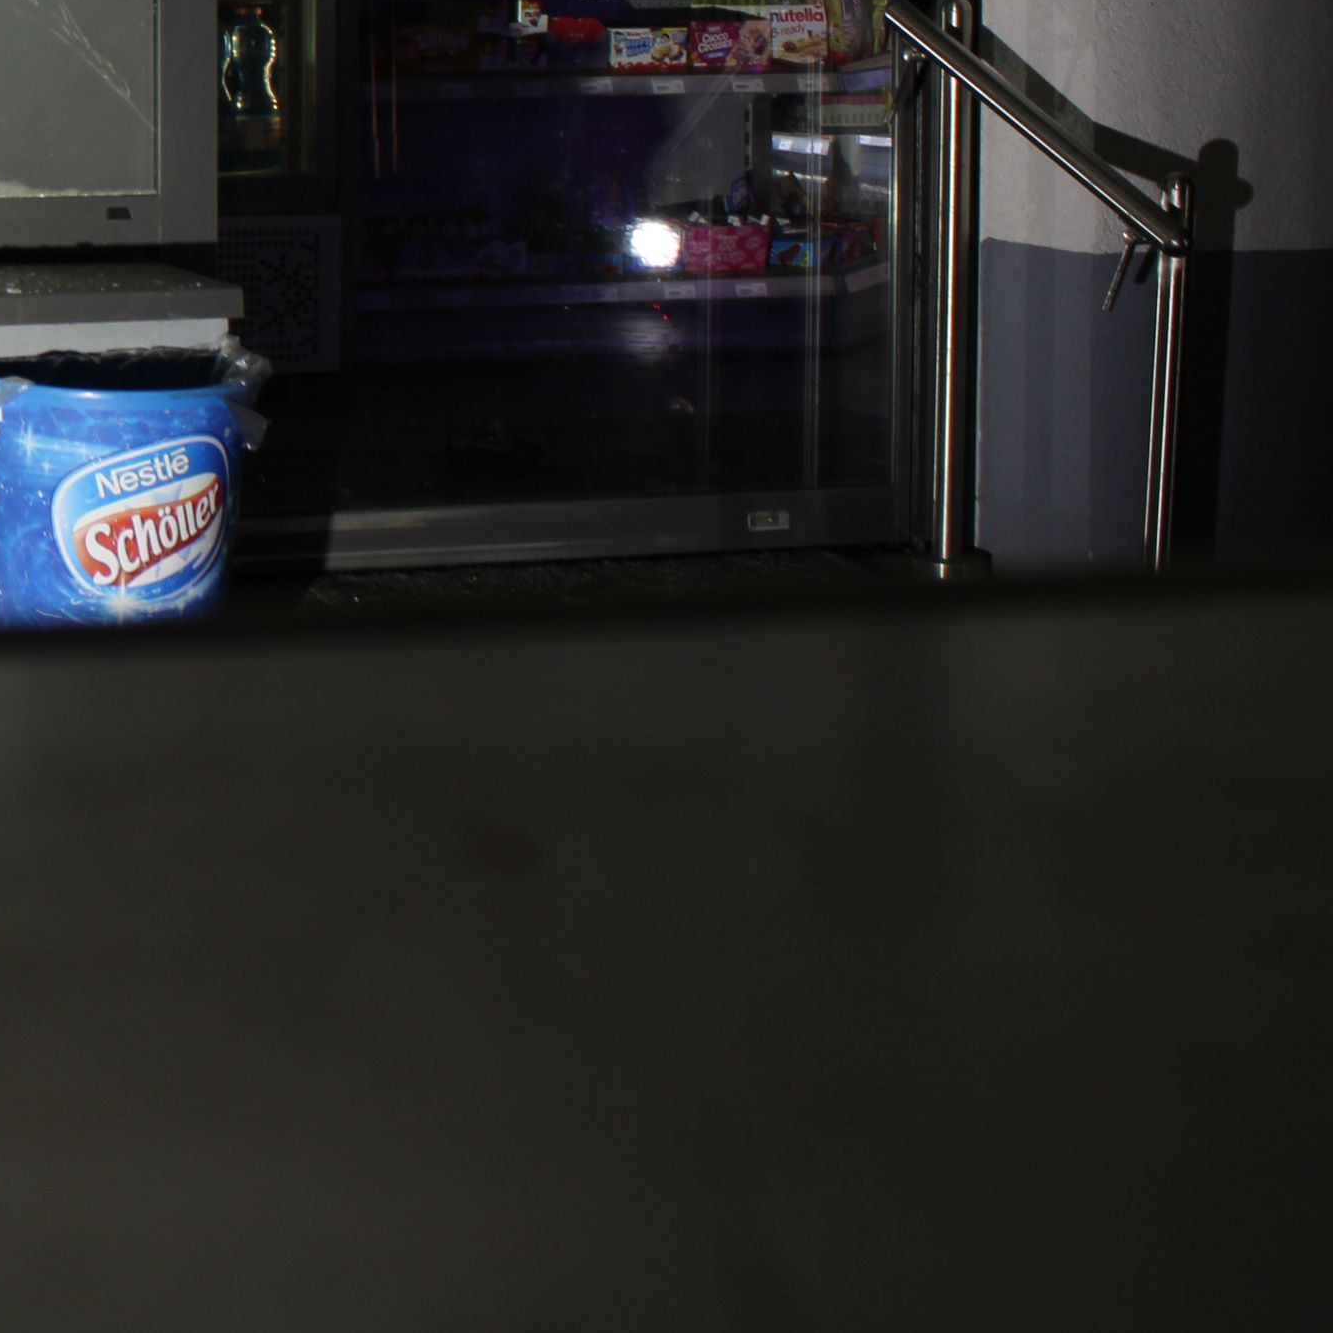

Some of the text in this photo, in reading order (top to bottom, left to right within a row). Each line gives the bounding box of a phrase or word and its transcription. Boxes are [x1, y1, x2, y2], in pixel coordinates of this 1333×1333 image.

[770, 9, 824, 23] nutella
[95, 447, 190, 499] Nestlé
[85, 482, 220, 586] Schöller
